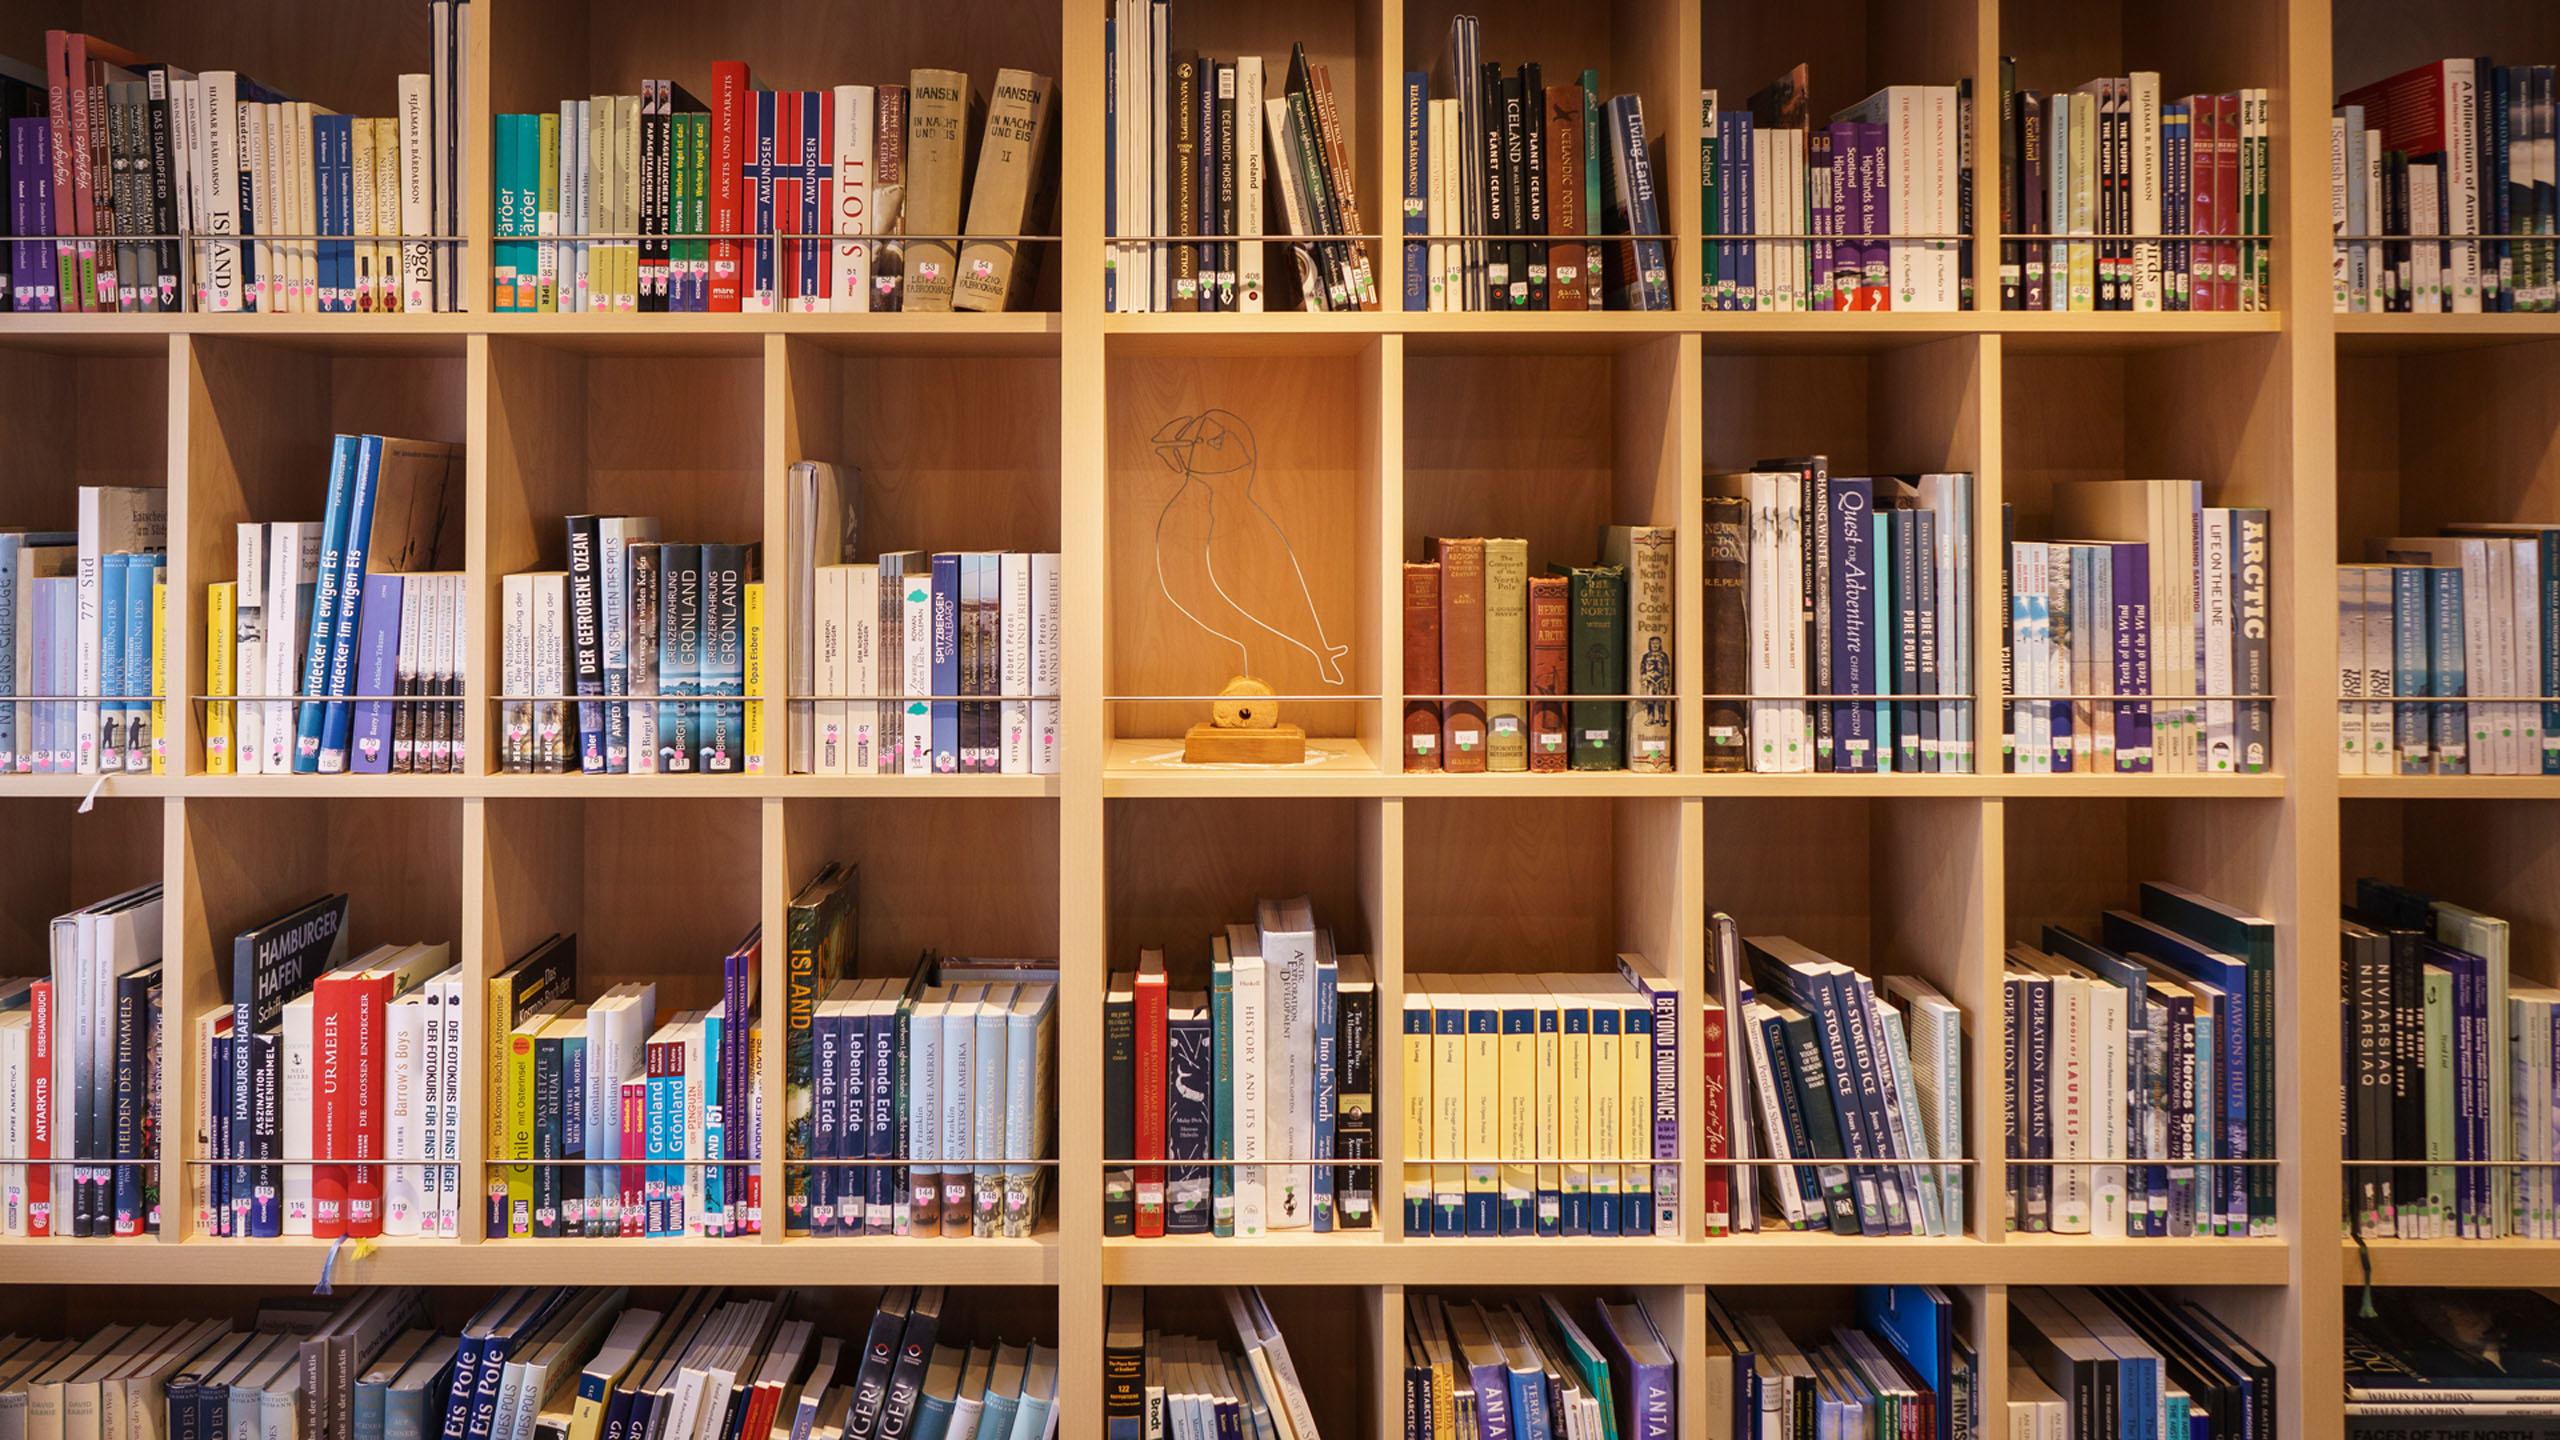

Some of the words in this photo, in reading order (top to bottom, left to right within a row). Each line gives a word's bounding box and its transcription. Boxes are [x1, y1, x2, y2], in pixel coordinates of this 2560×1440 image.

[724, 75, 733, 134] ANTARKTIS
[890, 94, 899, 113] EIS
[916, 87, 959, 102] NANSEN
[998, 86, 1042, 105] NANSEN
[2462, 81, 2472, 92] A
[53, 86, 65, 129] ISLAND
[153, 110, 163, 131] DAS
[881, 95, 890, 137] LANSING
[890, 115, 898, 130] IM
[991, 115, 1000, 125] IN
[1003, 117, 1037, 132] NACHT
[240, 104, 249, 169] Wunderwelt
[723, 136, 731, 159] UND
[890, 132, 898, 162] TAGE
[1222, 109, 1232, 162] ICELANDIC
[1507, 98, 1521, 164] ICELAND
[2025, 117, 2036, 161] Scotland
[2102, 121, 2111, 138] THE
[2462, 94, 2474, 175] Millennium
[53, 132, 70, 187] Highlights
[154, 133, 167, 200] ISLANDPFERD
[805, 137, 817, 205] AMUNDSEN
[880, 139, 889, 181] ALFRED
[1250, 154, 1258, 189] Iceland
[1489, 131, 1499, 172] PLANET
[1562, 128, 1573, 187] ICELANDIC
[1628, 114, 1644, 157] Living
[1636, 160, 1651, 201] Earth
[1702, 145, 1713, 187] Iceland
[1848, 147, 1857, 188] Scotland
[2103, 140, 2111, 175] PUFFIN
[721, 161, 729, 200] ARKTIS
[890, 165, 898, 181] 635
[1222, 164, 1232, 202] HORSES
[2465, 177, 2475, 191] of
[242, 176, 251, 212] Island
[841, 155, 864, 258] SCOTT
[1490, 175, 1500, 220] ICELAND
[1562, 189, 1573, 229] POETRY
[214, 210, 232, 289] ISLAND
[674, 261, 685, 270] 45
[925, 263, 936, 271] 53
[1868, 265, 1884, 273] 442
[1559, 267, 1576, 275] 427
[1817, 470, 1827, 516] CHASING
[1838, 491, 1864, 544] Quest
[2210, 525, 2222, 548] LIFE
[324, 550, 339, 571] Eis
[573, 532, 590, 570] OZEAN
[1638, 552, 1669, 566] Finding
[1818, 519, 1828, 569] WINTER
[1847, 545, 1857, 563] FOR
[2210, 552, 2222, 569] ON
[82, 558, 95, 588] Süd
[1640, 569, 1667, 579] North
[1643, 583, 1665, 594] Pole
[2211, 572, 2222, 593] THE
[2242, 520, 2266, 640] ARCTIC
[320, 574, 337, 618] ewigen
[575, 575, 595, 647] GEFRORENE
[1638, 603, 1670, 614] Cook
[1846, 563, 1865, 654] Adventure
[2212, 598, 2223, 626] LINE
[318, 620, 329, 639] im
[666, 571, 678, 665] GRENZERFAHRUNG
[678, 570, 697, 666] GRÖNLAND
[935, 592, 945, 665] SPITZBERGEN
[945, 600, 954, 655] SVALBARD
[1638, 621, 1669, 634] Peary
[1904, 610, 1915, 638] PURE
[580, 650, 596, 674] DER
[1849, 656, 1859, 682] CHRIS
[1904, 641, 1915, 673] POWER
[1850, 684, 1861, 737] BOINGTON
[213, 737, 225, 746] 65
[940, 756, 952, 764] 92
[259, 908, 339, 970] HAMBURGER
[258, 956, 302, 1001] HAFEN
[1293, 949, 1306, 983] ARCTIC
[790, 949, 812, 1030] ISLAND
[1279, 971, 1291, 1040] DEVELOPMENT
[1287, 958, 1298, 1024] EXPLORATION
[1820, 986, 1830, 1008] THE
[38, 990, 46, 1058] REISEHANDBUCH
[120, 996, 133, 1064] HIMMELS
[237, 1003, 249, 1046] HAFEN
[360, 993, 370, 1061] ENTDECKER
[427, 1020, 438, 1042] DER
[1245, 1005, 1255, 1064] HISTORY
[1656, 998, 1675, 1046] BEYOND
[1824, 1009, 1847, 1070] STORIED
[2033, 987, 2045, 1067] OPERATION
[2182, 1023, 2195, 1047] Let
[2360, 964, 2375, 1087] NIVIARSIAQ
[325, 1012, 339, 1094] URMEER
[396, 1031, 409, 1059] Boys
[823, 1033, 837, 1095] Lebende
[1320, 1037, 1334, 1063] Into
[120, 1067, 131, 1094] DES
[236, 1049, 249, 1121] HAMBURGER
[265, 1046, 275, 1136] STERNENHIMMEL
[359, 1064, 369, 1109] GROSSEN
[395, 1063, 409, 1118] Barrow's
[427, 1045, 437, 1103] FOTOKURS
[538, 1057, 549, 1102] LETZTE
[550, 1072, 559, 1115] RITUAL
[1246, 1072, 1255, 1100] AND
[1320, 1066, 1331, 1085] the
[1656, 1050, 1676, 1123] ENDURANCE
[1837, 1072, 1853, 1097] ICE
[2182, 1050, 2195, 1110] Heroes
[36, 1077, 47, 1142] ANTARKTIS
[256, 1068, 265, 1136] FASZINATION
[426, 1105, 436, 1127] FÜR
[537, 1105, 548, 1128] DAS
[649, 1081, 664, 1154] Grönland
[707, 1105, 723, 1130] 151
[822, 1101, 836, 1133] Erde
[1246, 1107, 1255, 1128] ITS
[1319, 1089, 1332, 1123] North
[2034, 1071, 2045, 1139] TABARIN
[2067, 1060, 2079, 1136] LAURELS
[119, 1097, 131, 1155] HELDEN
[359, 1111, 369, 1127] DIE
[2185, 1114, 2196, 1160] Speak
[514, 1131, 529, 1173] Chile
[706, 1135, 719, 1180] ISAND
[392, 1203, 408, 1212] 119
[491, 1185, 506, 1193] 122
[918, 1187, 934, 1197] 144
[649, 1201, 664, 1231] DUMONT
[478, 1350, 504, 1396] Pole
[470, 1403, 493, 1438] Eis
[1150, 1398, 1161, 1431] Bradt
[1407, 1380, 1415, 1430] ANTARCTIC
[1648, 1387, 1667, 1437] ANTA
